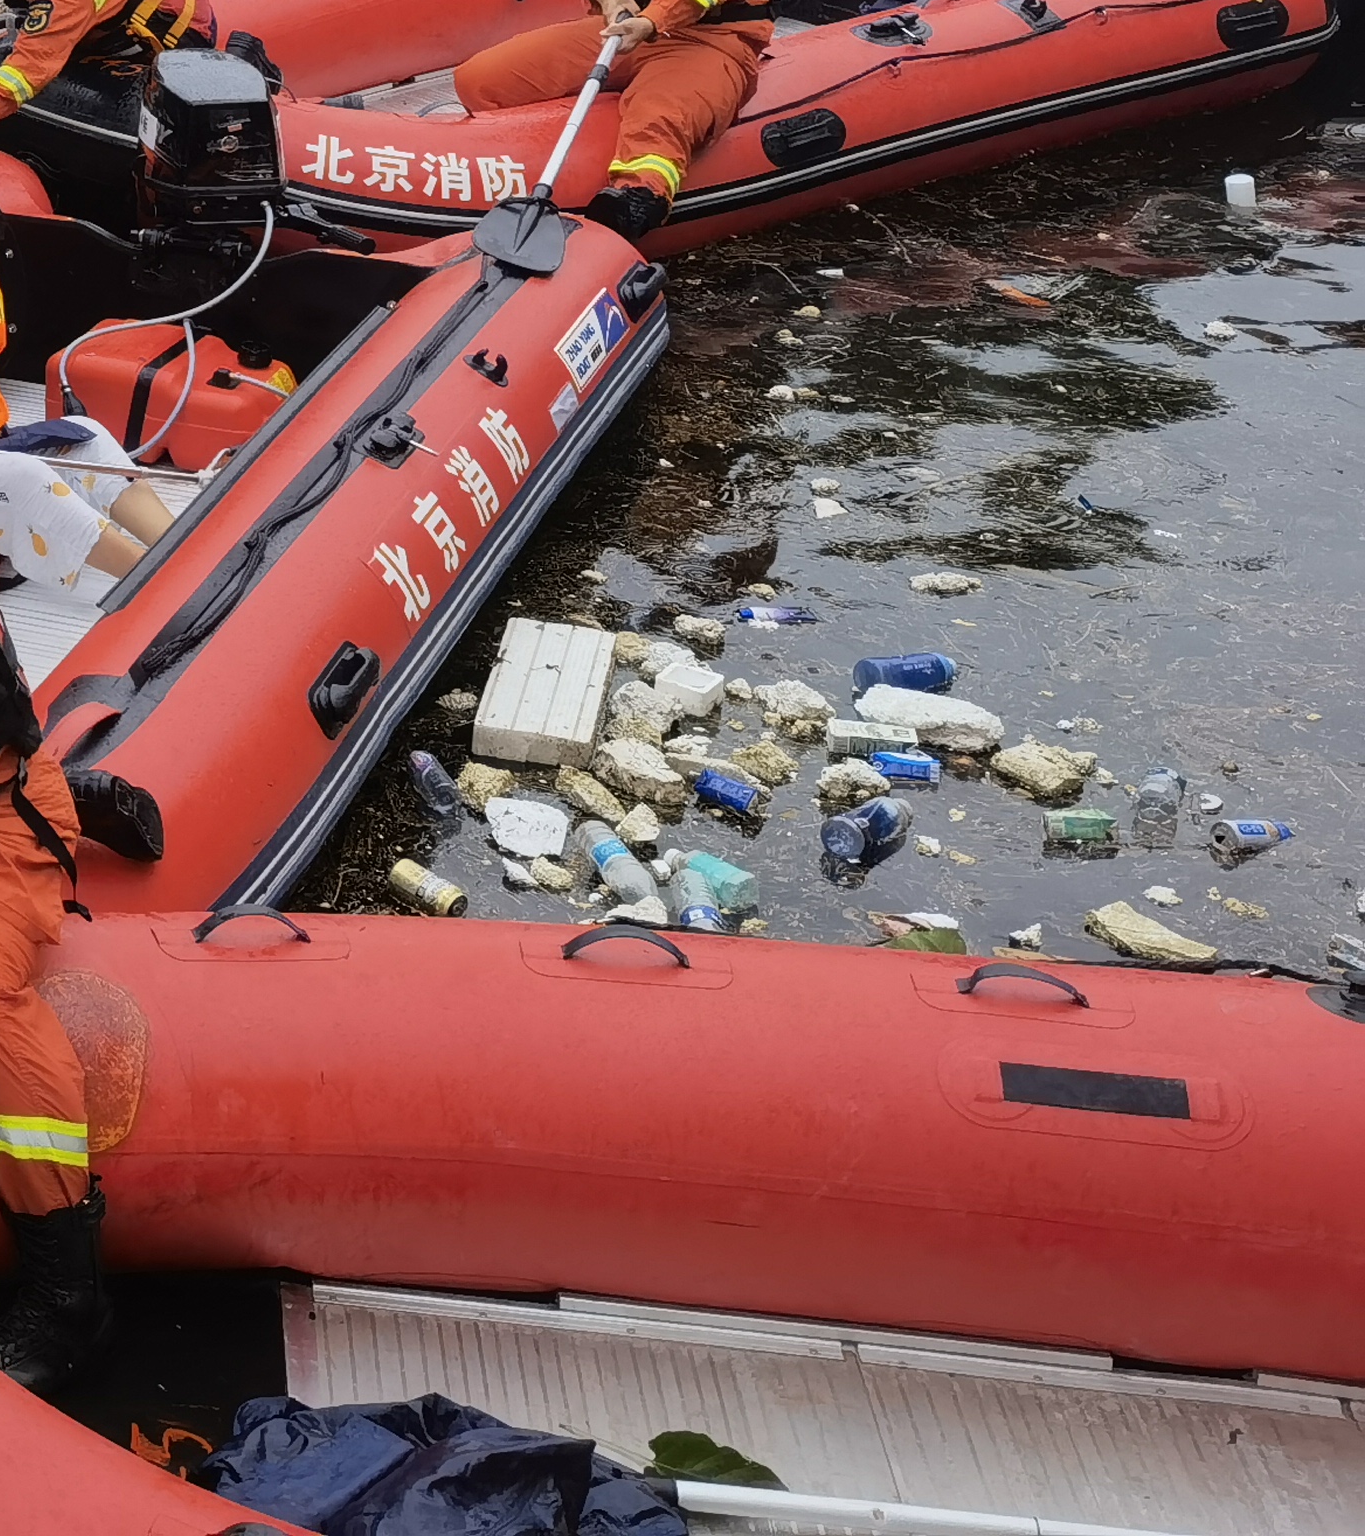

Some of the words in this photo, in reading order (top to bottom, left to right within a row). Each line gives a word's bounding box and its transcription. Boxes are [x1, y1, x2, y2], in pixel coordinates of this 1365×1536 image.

[301, 133, 528, 203] 北京消防
[373, 406, 531, 622] 北京消防
